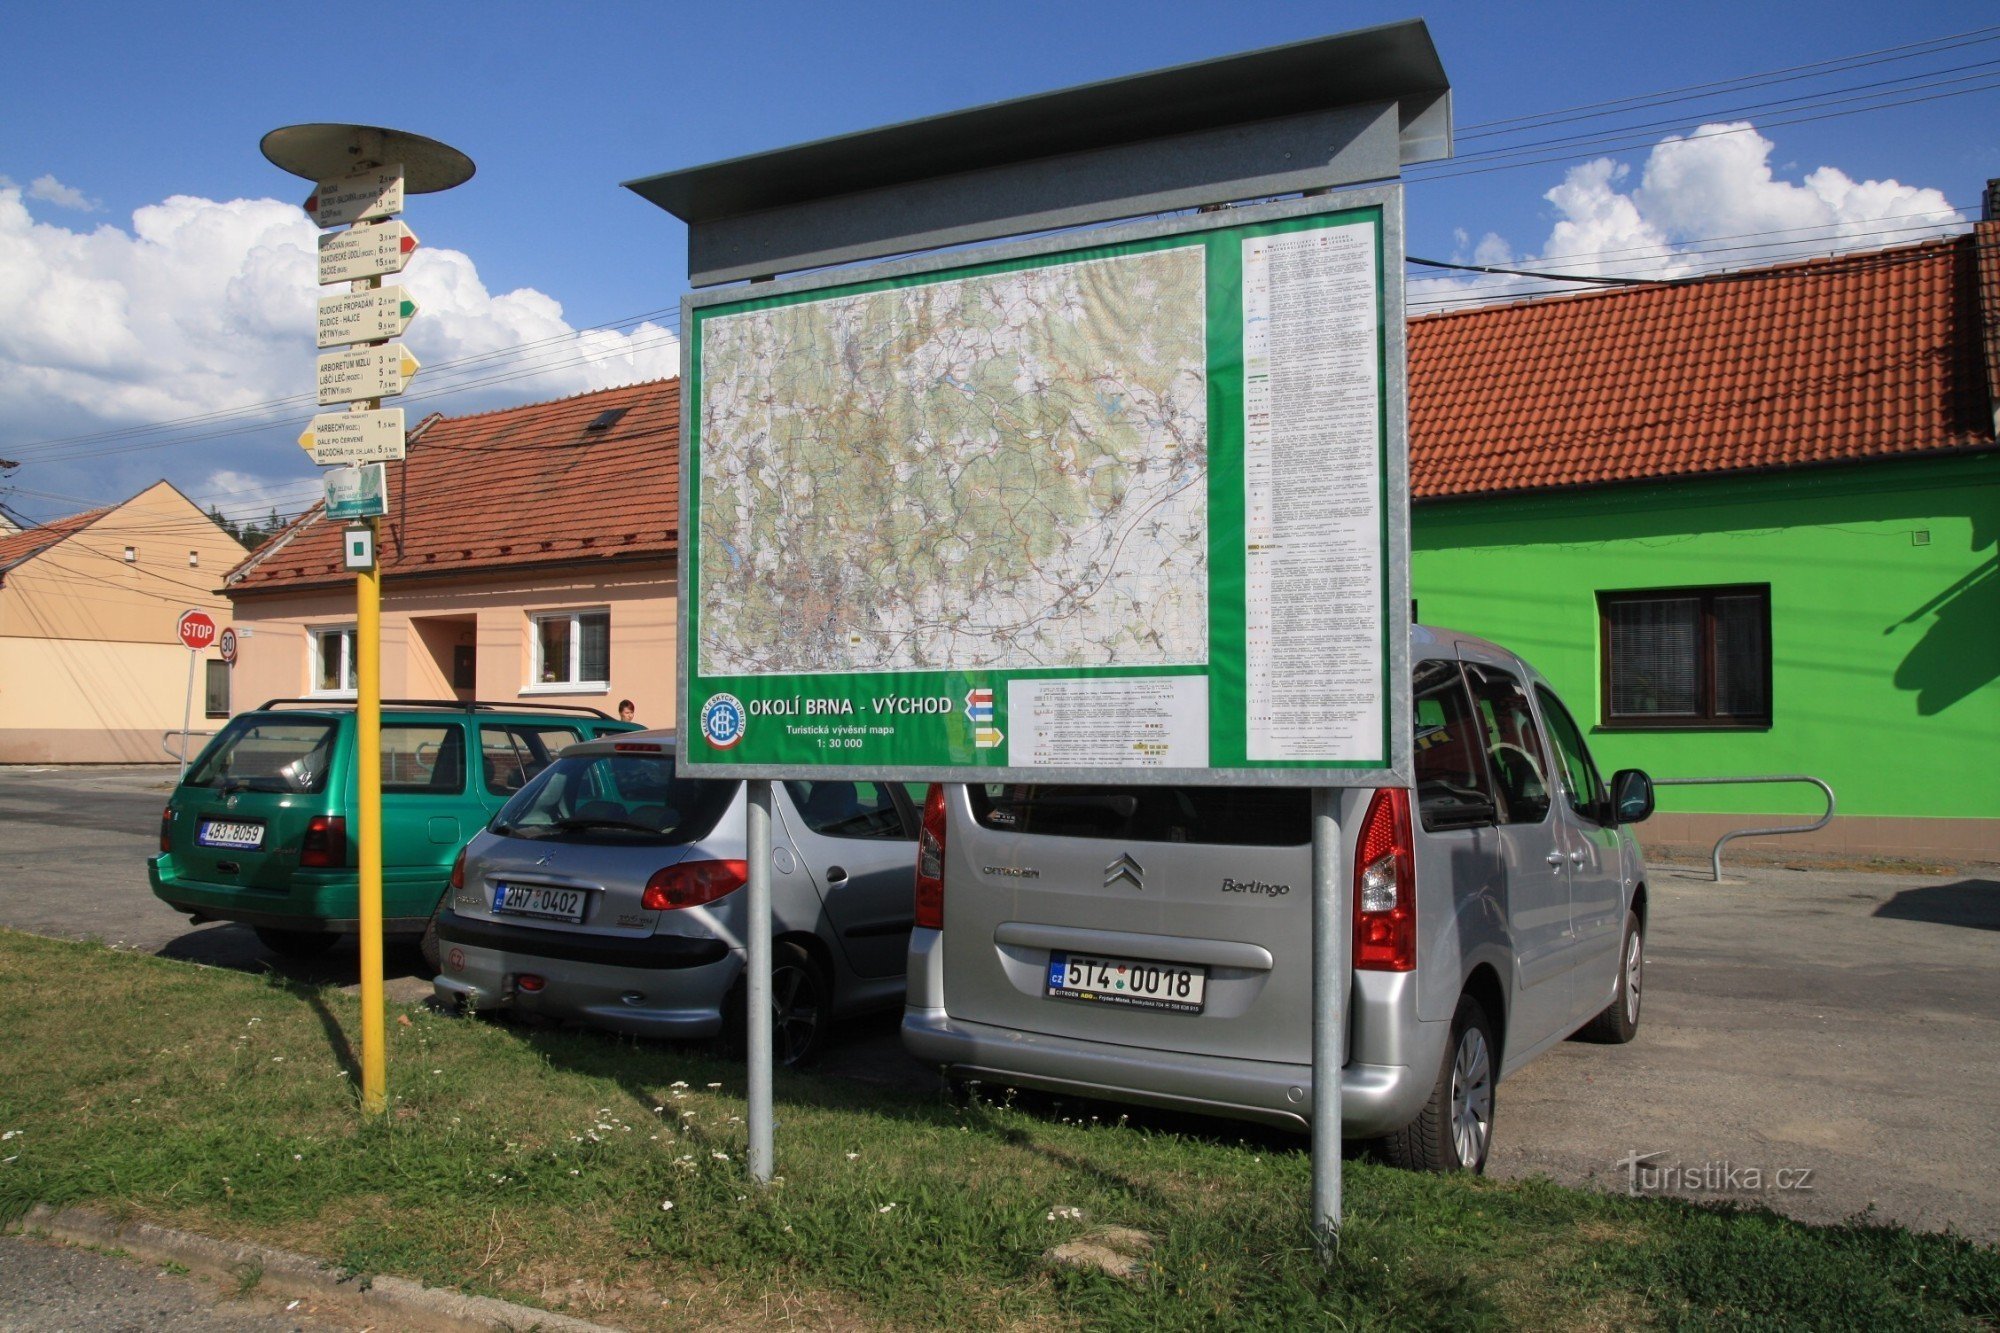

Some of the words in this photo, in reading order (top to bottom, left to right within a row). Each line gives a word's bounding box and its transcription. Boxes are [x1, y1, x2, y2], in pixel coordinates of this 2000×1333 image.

[375, 199, 383, 209] 13
[320, 316, 339, 328] RUDICE
[378, 309, 383, 317] 4
[320, 360, 354, 372] ARBORETUM
[379, 356, 383, 364] 3
[379, 369, 383, 377] 5
[183, 622, 213, 639] STOP
[223, 636, 234, 652] 30
[749, 695, 800, 717] OKOLÍ
[805, 698, 854, 716] BRNA
[872, 693, 952, 715] VÝCHOD
[786, 724, 829, 735] Turistická
[832, 724, 866, 736] vývěsní
[869, 725, 895, 737] mapa
[829, 738, 842, 749] 30
[844, 738, 863, 749] 000
[208, 822, 228, 840] 4B3
[232, 824, 259, 842] 8059
[1222, 878, 1290, 898] Berlingo
[505, 886, 533, 909] 2H7
[541, 888, 578, 914] 0402
[1051, 974, 1062, 984] CZ
[1069, 958, 1110, 989] 5T4
[1129, 965, 1192, 998] 0018
